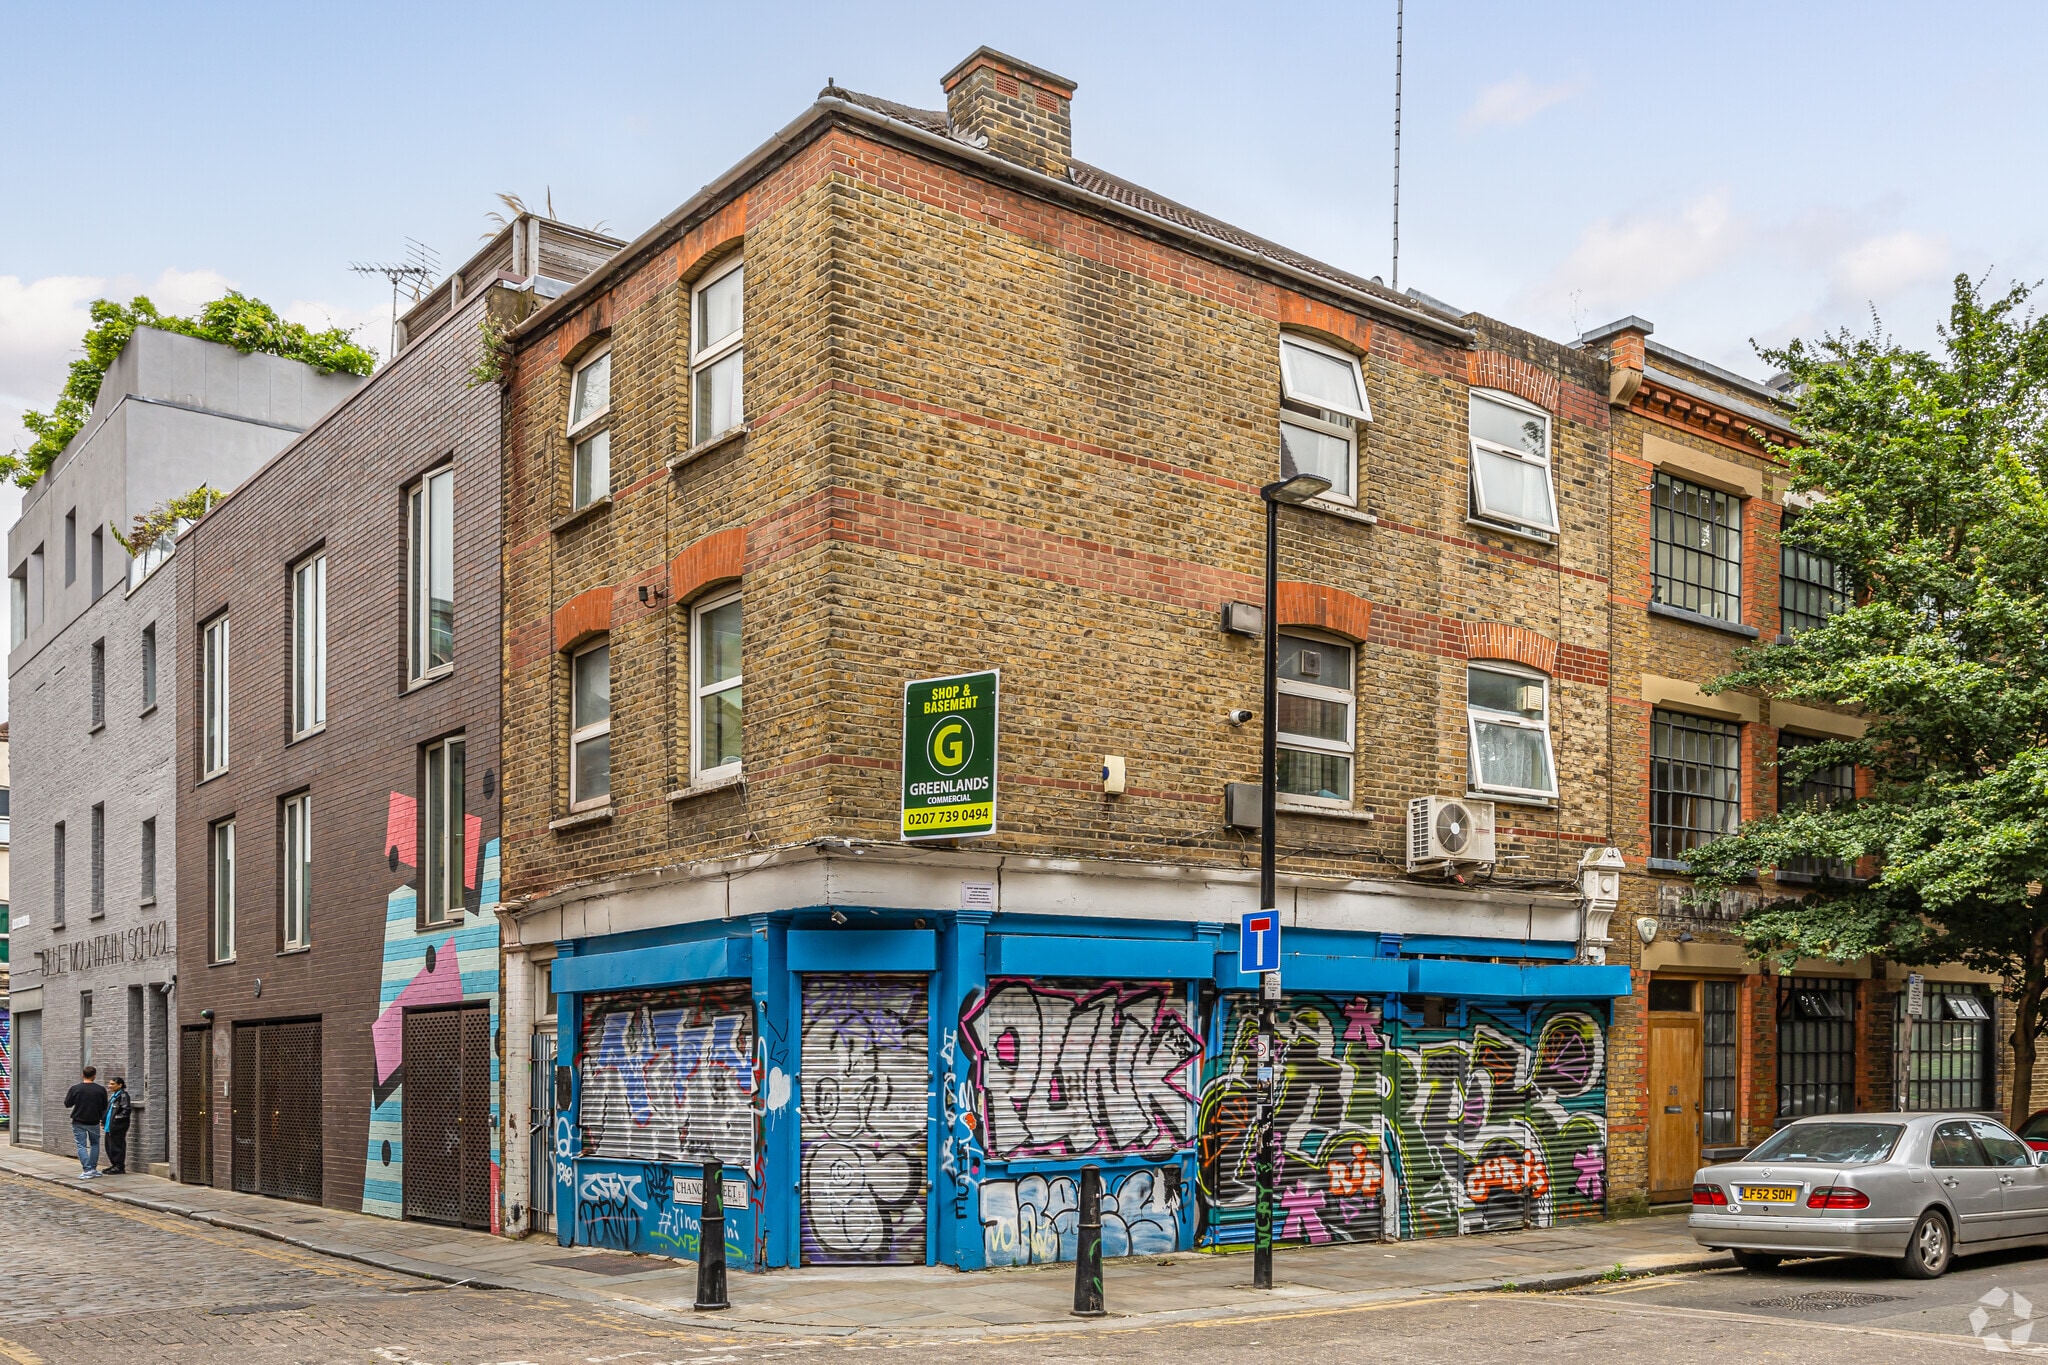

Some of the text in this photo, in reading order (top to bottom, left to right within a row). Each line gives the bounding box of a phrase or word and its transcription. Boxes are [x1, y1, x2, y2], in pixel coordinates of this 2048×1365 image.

[932, 684, 970, 700] SHOP &
[923, 696, 978, 714] BASEMENT
[934, 724, 963, 767] G
[909, 776, 989, 796] GREENLANDS
[927, 793, 971, 805] COMMERCIAL
[908, 807, 989, 825] 0207 739 0494
[1668, 1085, 1679, 1096] 26
[675, 1181, 703, 1195] CHANC
[1743, 1188, 1769, 1200] LF52
